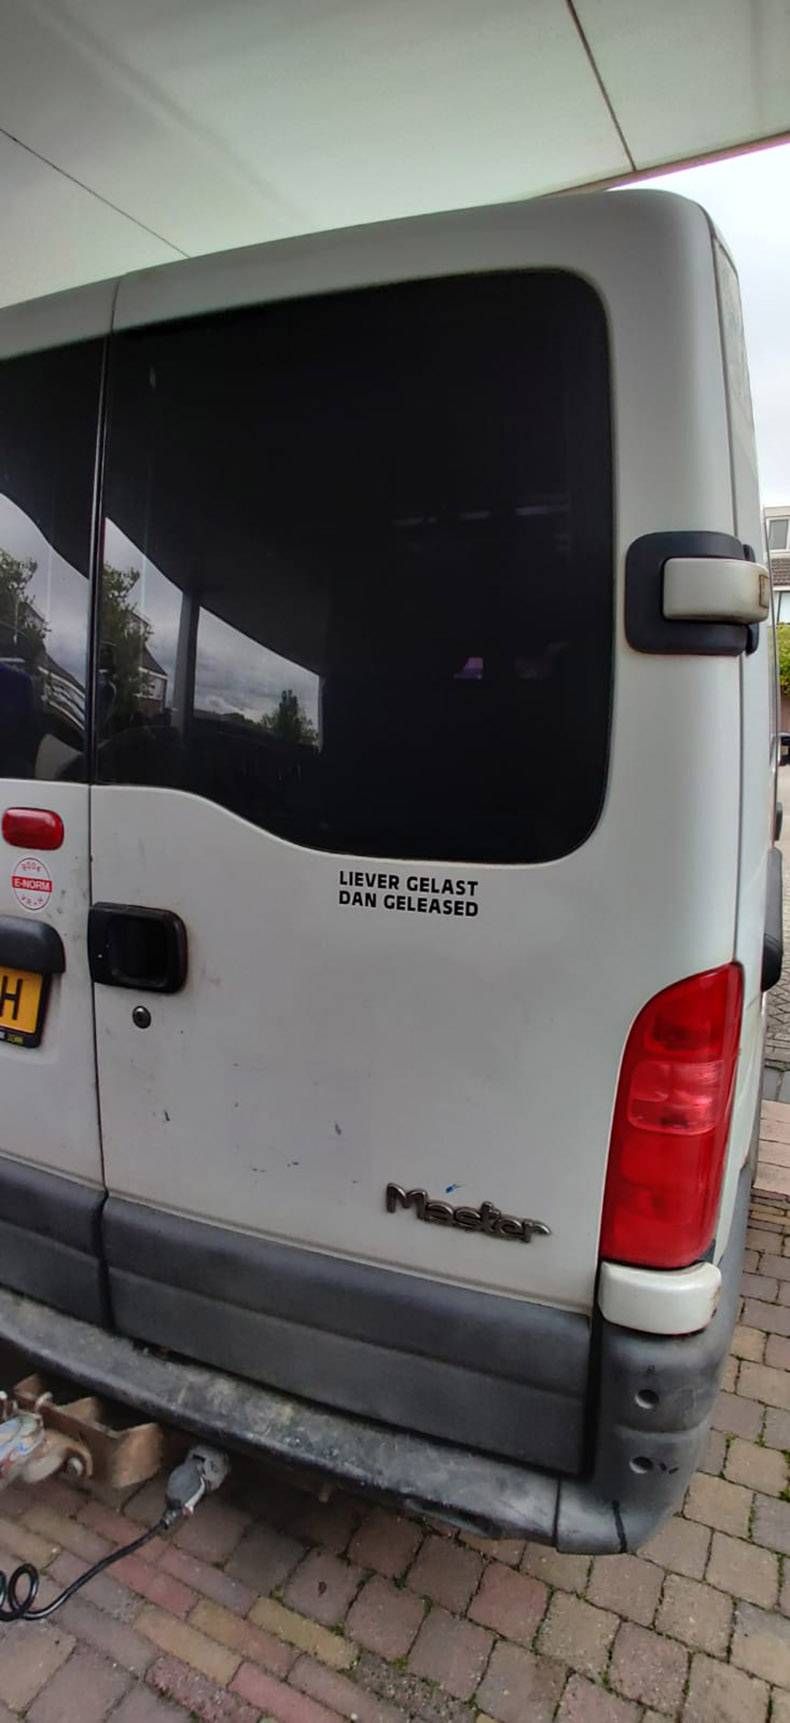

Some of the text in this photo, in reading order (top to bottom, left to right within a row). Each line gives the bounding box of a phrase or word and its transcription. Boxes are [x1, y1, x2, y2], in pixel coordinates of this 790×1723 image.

[13, 878, 51, 891] E-NORM
[339, 870, 479, 896] LIEVER GELAST
[339, 890, 479, 917] DAN GELEASED
[386, 1182, 552, 1243] Master
